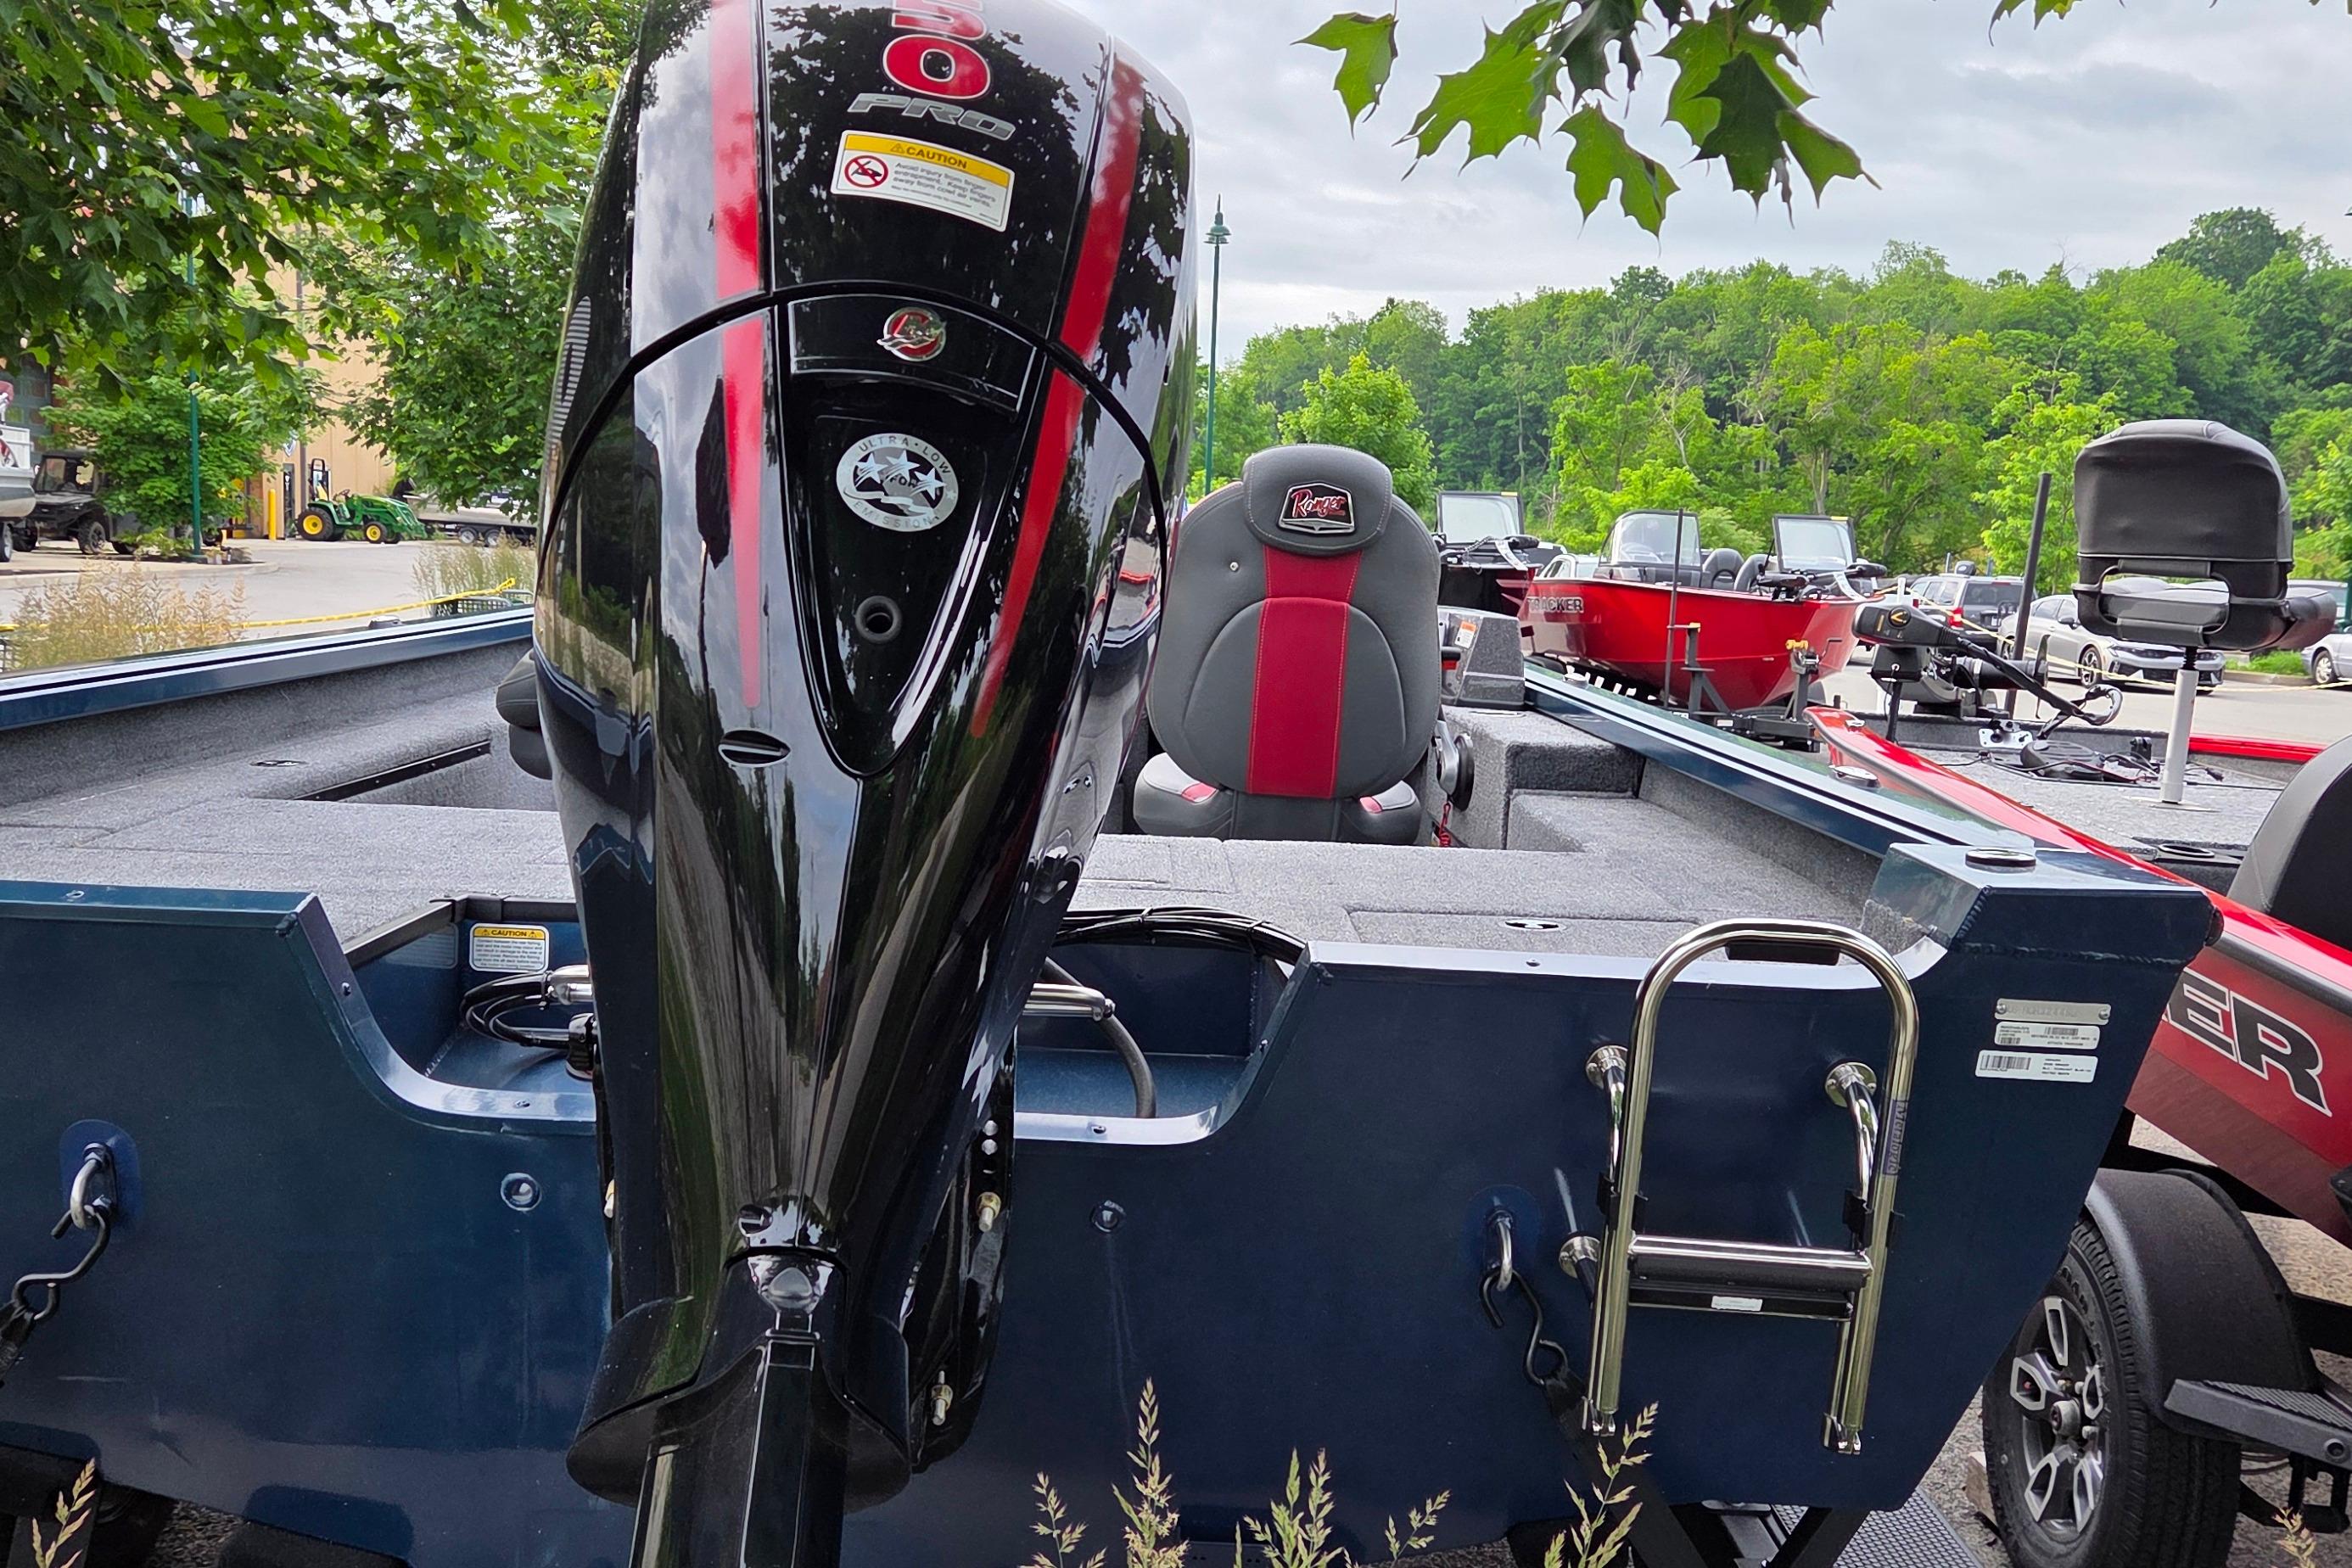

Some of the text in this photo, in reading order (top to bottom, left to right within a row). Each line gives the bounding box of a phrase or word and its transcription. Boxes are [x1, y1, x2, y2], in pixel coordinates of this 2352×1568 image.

[846, 92, 1016, 141] PRO
[905, 147, 967, 170] CAUTION
[893, 177, 915, 188] away
[916, 181, 936, 191] from
[957, 191, 967, 199] air
[895, 162, 988, 192] Avoid injury from finger
[947, 182, 968, 193] Keep
[970, 188, 997, 203] fingers
[859, 435, 951, 474] ULTRA LOW
[1291, 489, 1347, 518] Ranger
[1526, 596, 1584, 613] TRACKER
[2162, 966, 2333, 1117] ER
